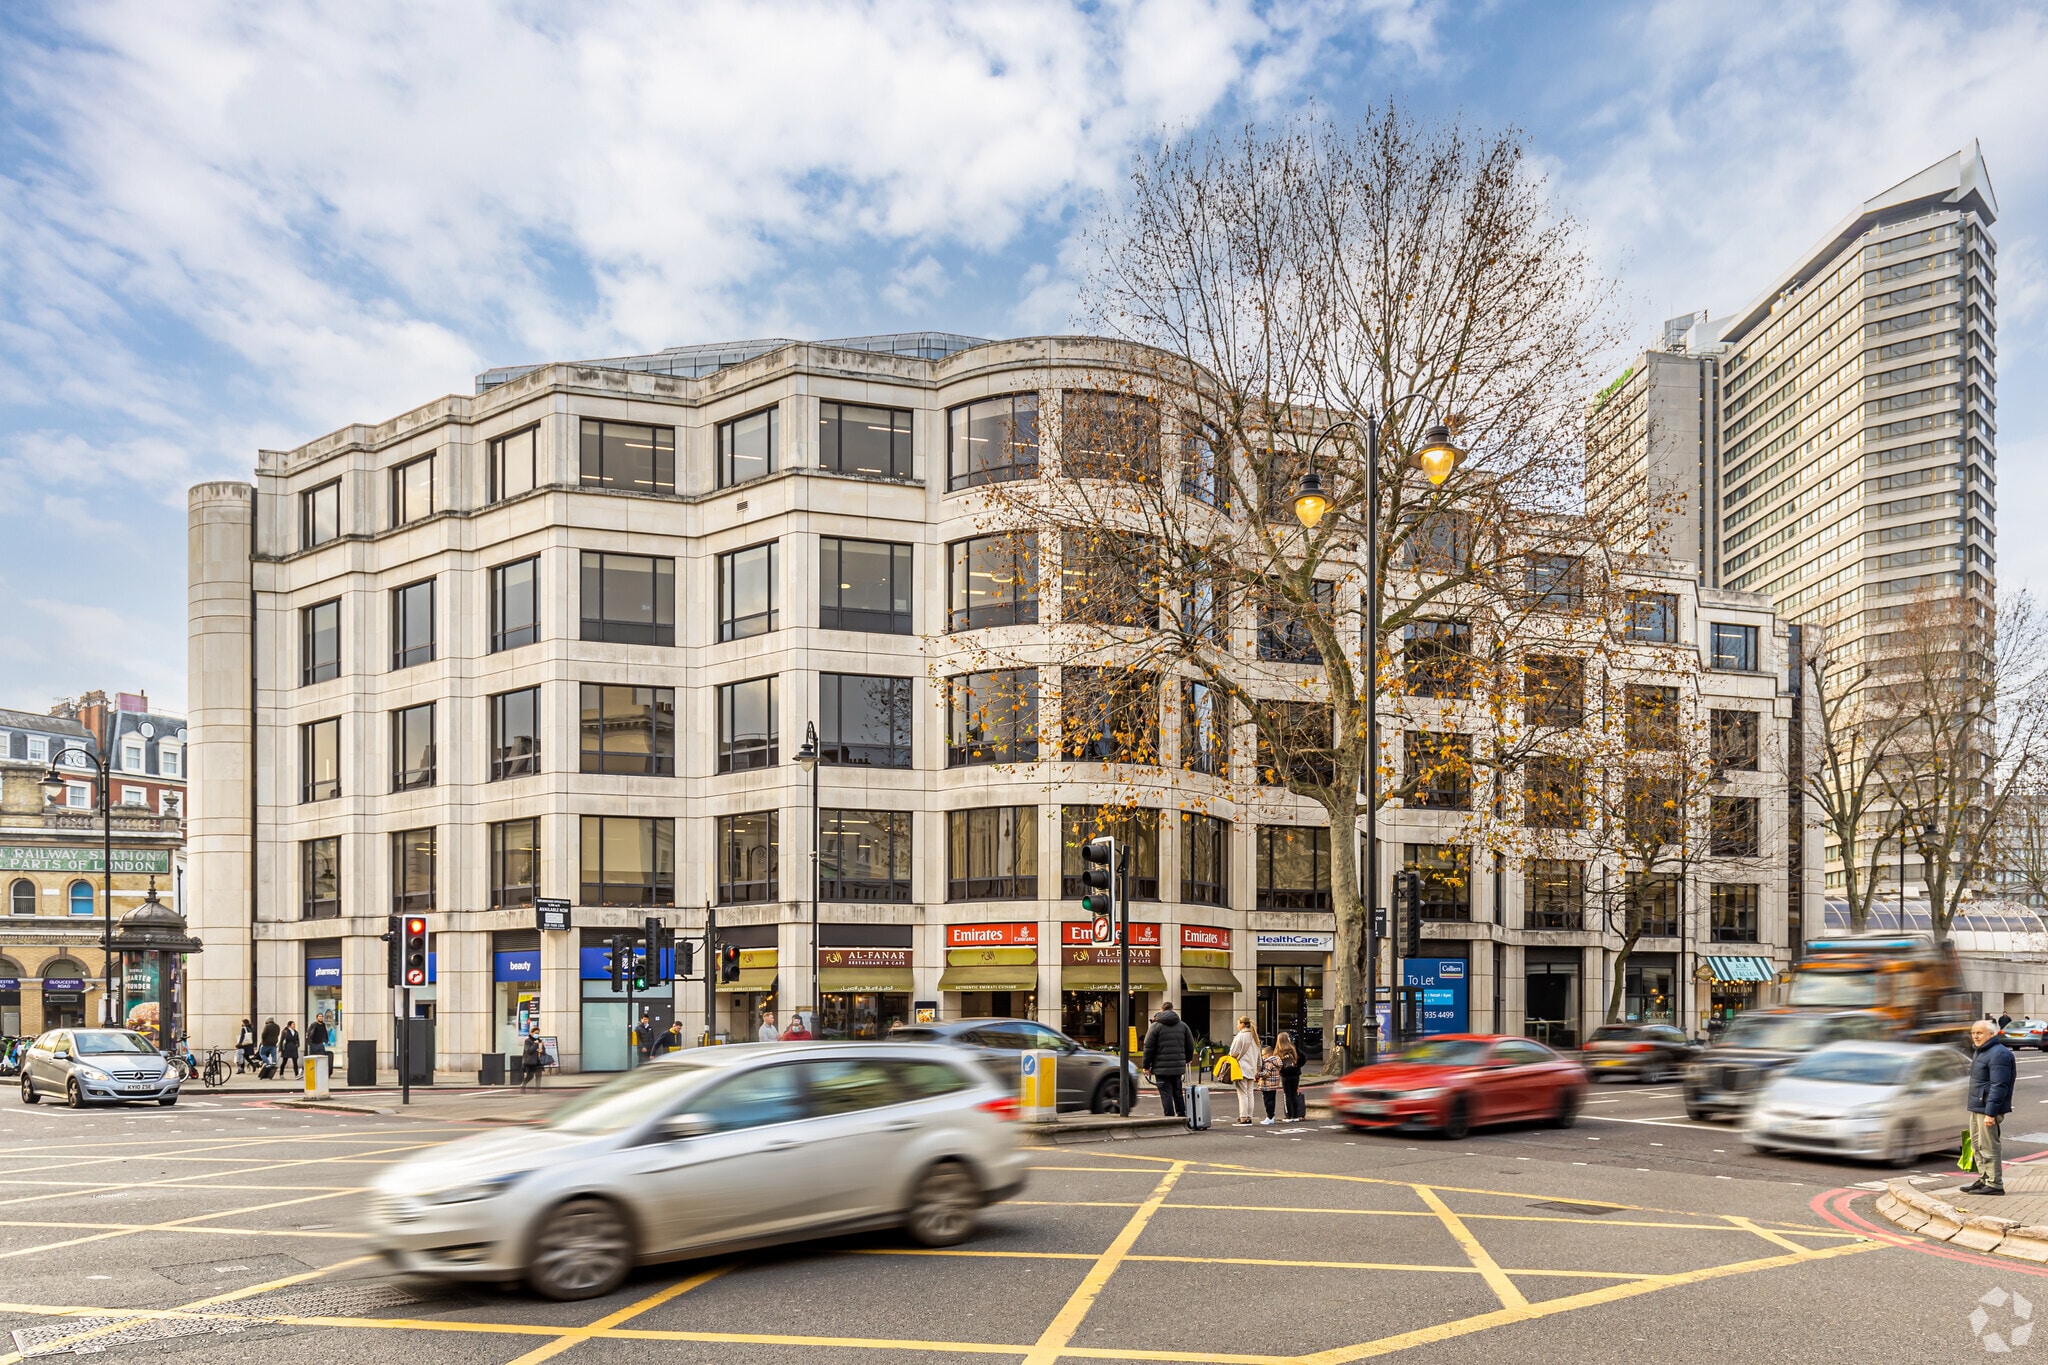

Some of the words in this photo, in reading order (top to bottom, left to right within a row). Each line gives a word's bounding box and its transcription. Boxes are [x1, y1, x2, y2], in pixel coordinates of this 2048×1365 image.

[14, 848, 78, 859] RAILWAY
[89, 851, 156, 861] STATION
[10, 859, 61, 869] PARTS
[68, 860, 87, 870] OF
[953, 928, 1003, 942] Emirates
[1184, 929, 1218, 944] Emirates
[1257, 935, 1319, 944] HealthCare
[848, 951, 905, 959] AL-FANAR
[1097, 949, 1151, 957] AL-FNAR
[510, 961, 531, 972] beauty
[316, 968, 340, 977] pharmacy
[1408, 975, 1418, 985] To
[1420, 976, 1435, 986] Let
